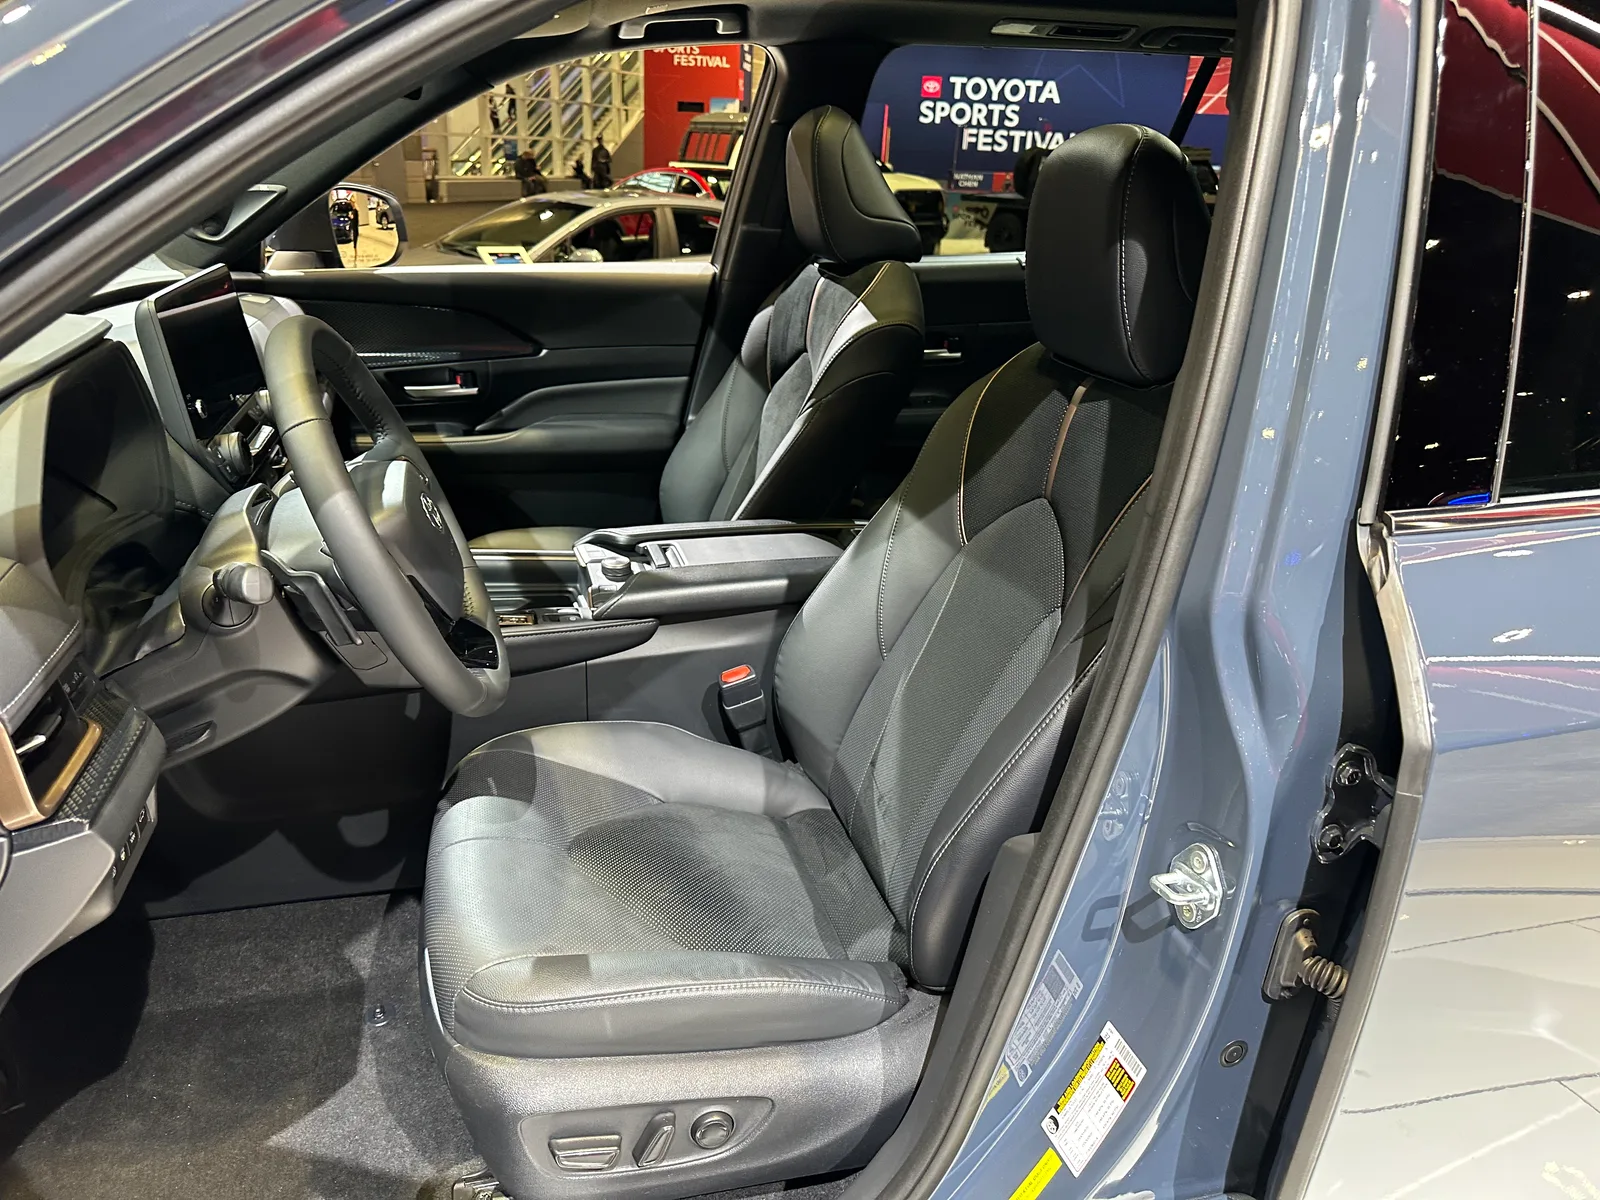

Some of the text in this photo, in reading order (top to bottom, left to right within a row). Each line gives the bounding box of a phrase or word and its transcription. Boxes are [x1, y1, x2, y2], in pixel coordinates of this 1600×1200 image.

[673, 55, 731, 68] FESTIVAL
[950, 76, 1061, 104] TOYOTA
[919, 100, 1020, 127] SPORTS
[962, 128, 1076, 153] FESTIVA
